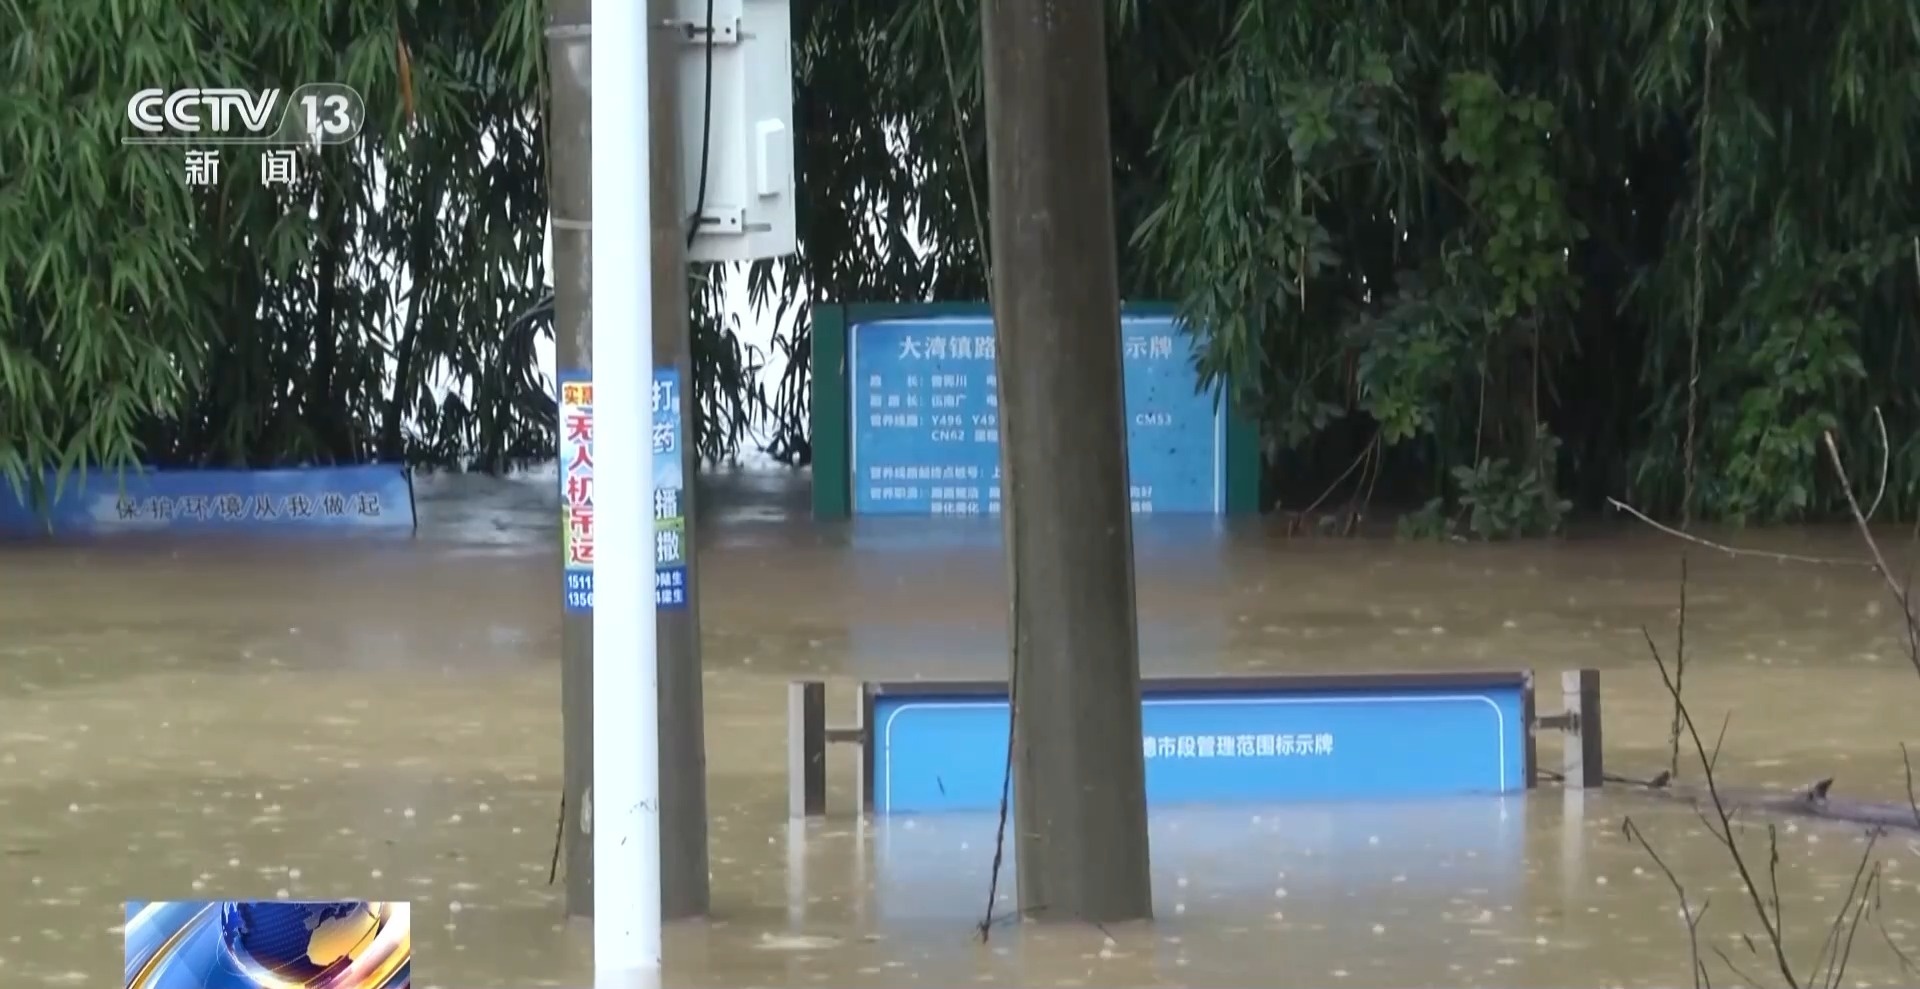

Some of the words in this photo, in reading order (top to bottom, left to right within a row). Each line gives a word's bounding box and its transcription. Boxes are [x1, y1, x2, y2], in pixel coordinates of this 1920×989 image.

[899, 335, 996, 360] 大湾镇路
[1126, 336, 1172, 360] 示牌
[652, 380, 675, 453] 打药
[566, 414, 593, 564] 无人机吊运
